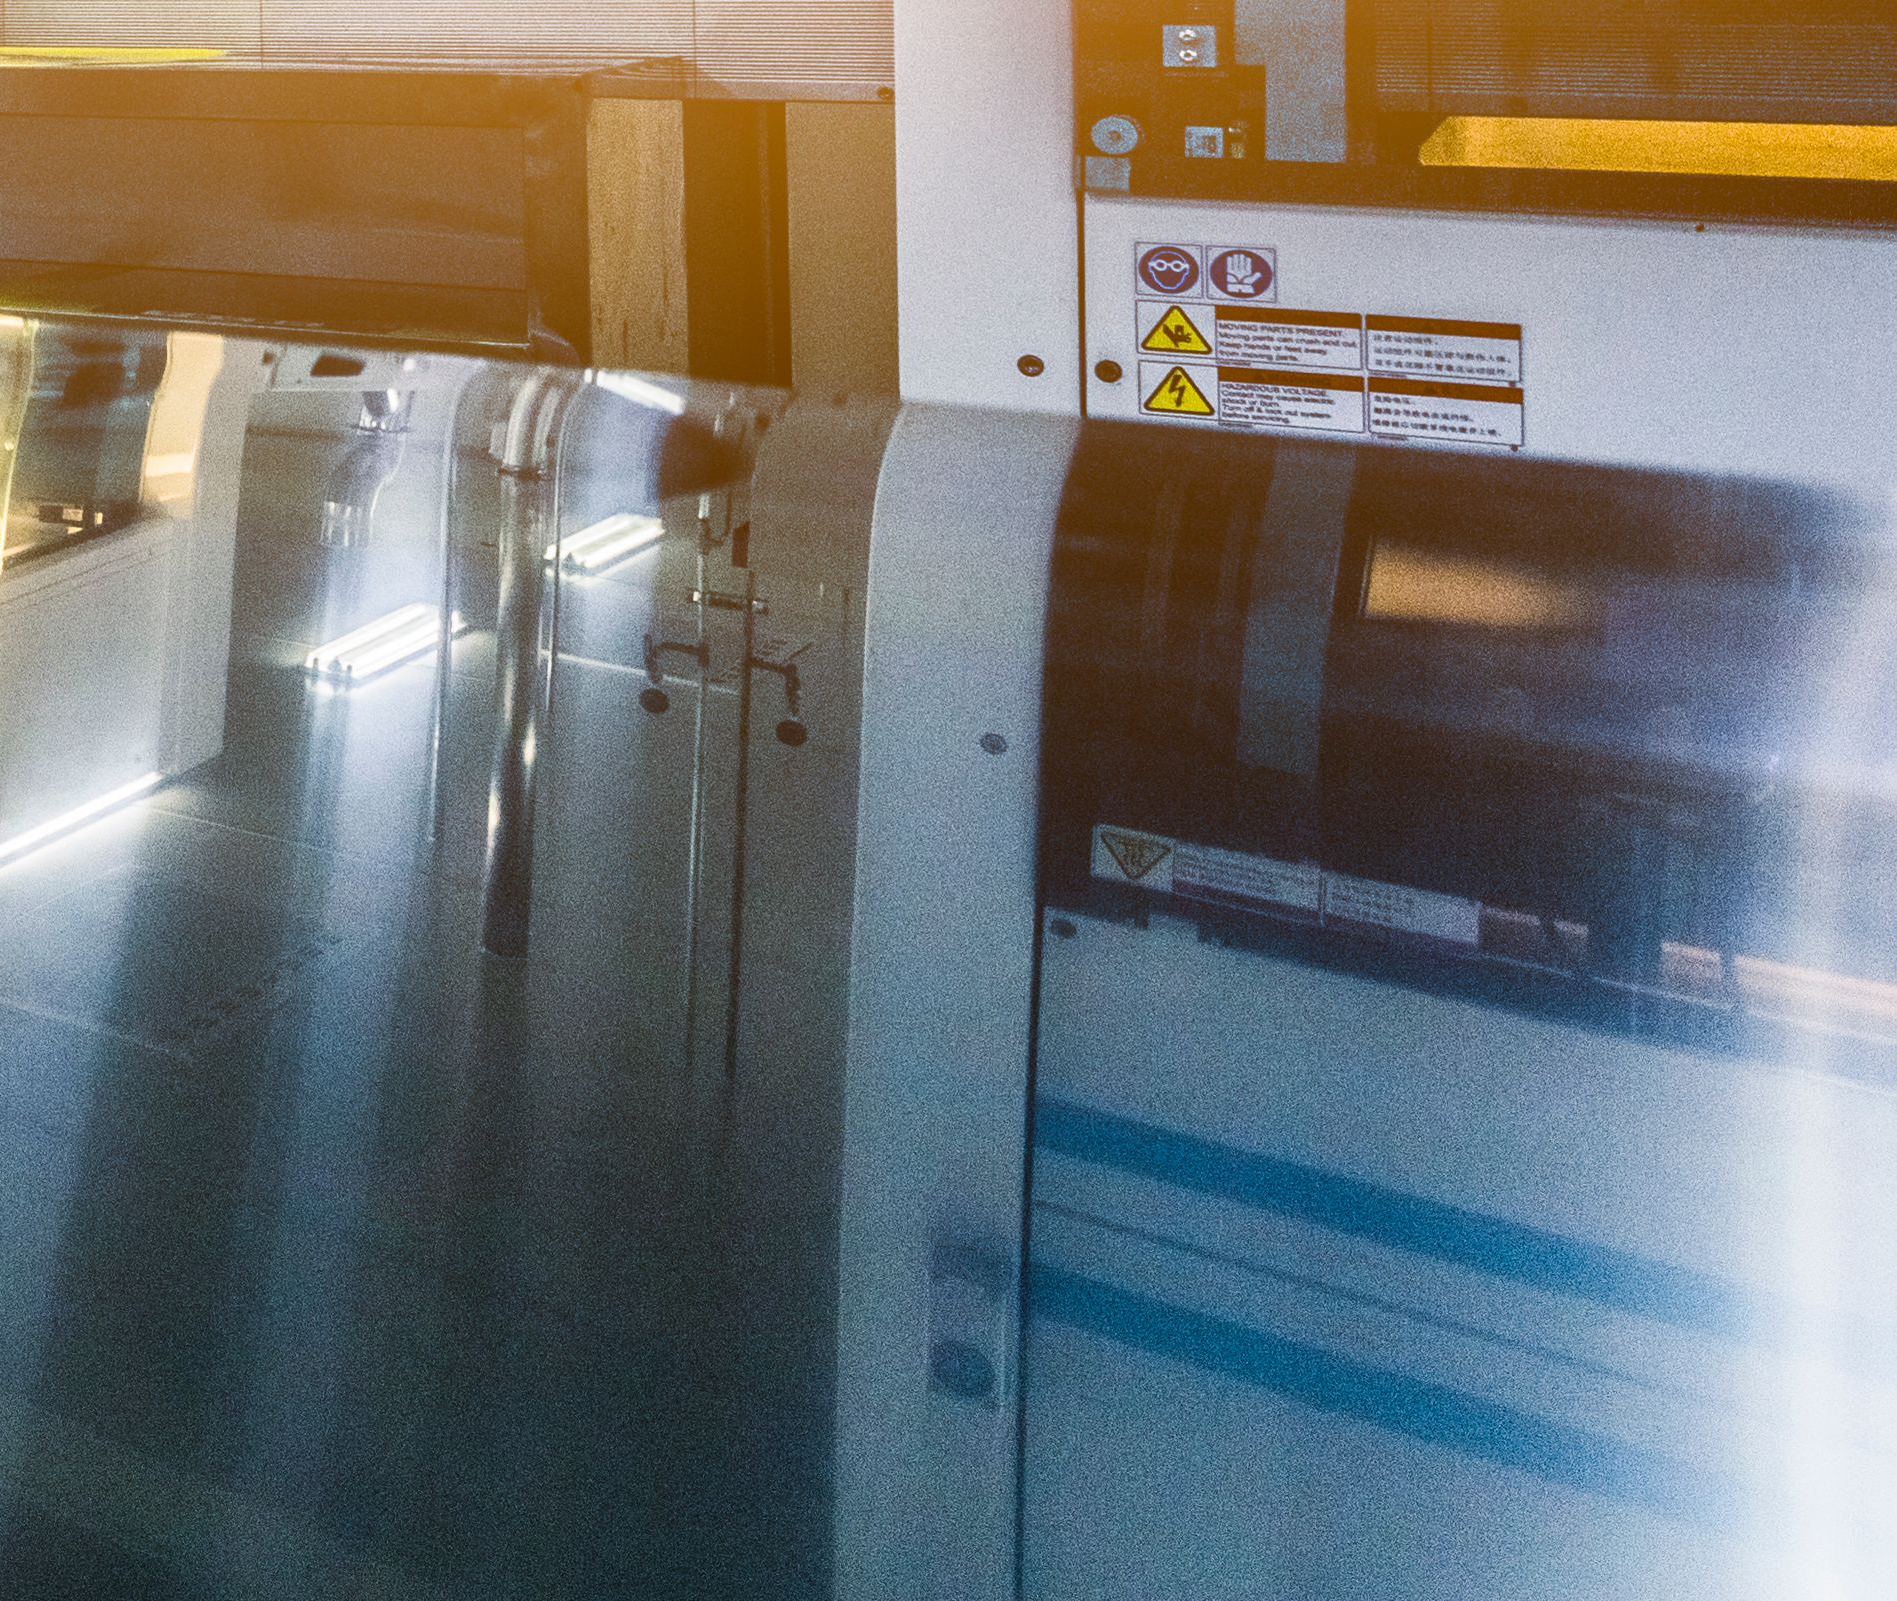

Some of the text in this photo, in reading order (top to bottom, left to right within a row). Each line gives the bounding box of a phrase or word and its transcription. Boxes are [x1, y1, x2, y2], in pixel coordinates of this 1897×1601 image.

[1218, 322, 1258, 332] MOVING
[1260, 324, 1294, 334] PARTS
[1221, 383, 1280, 393] HAZARDOUS
